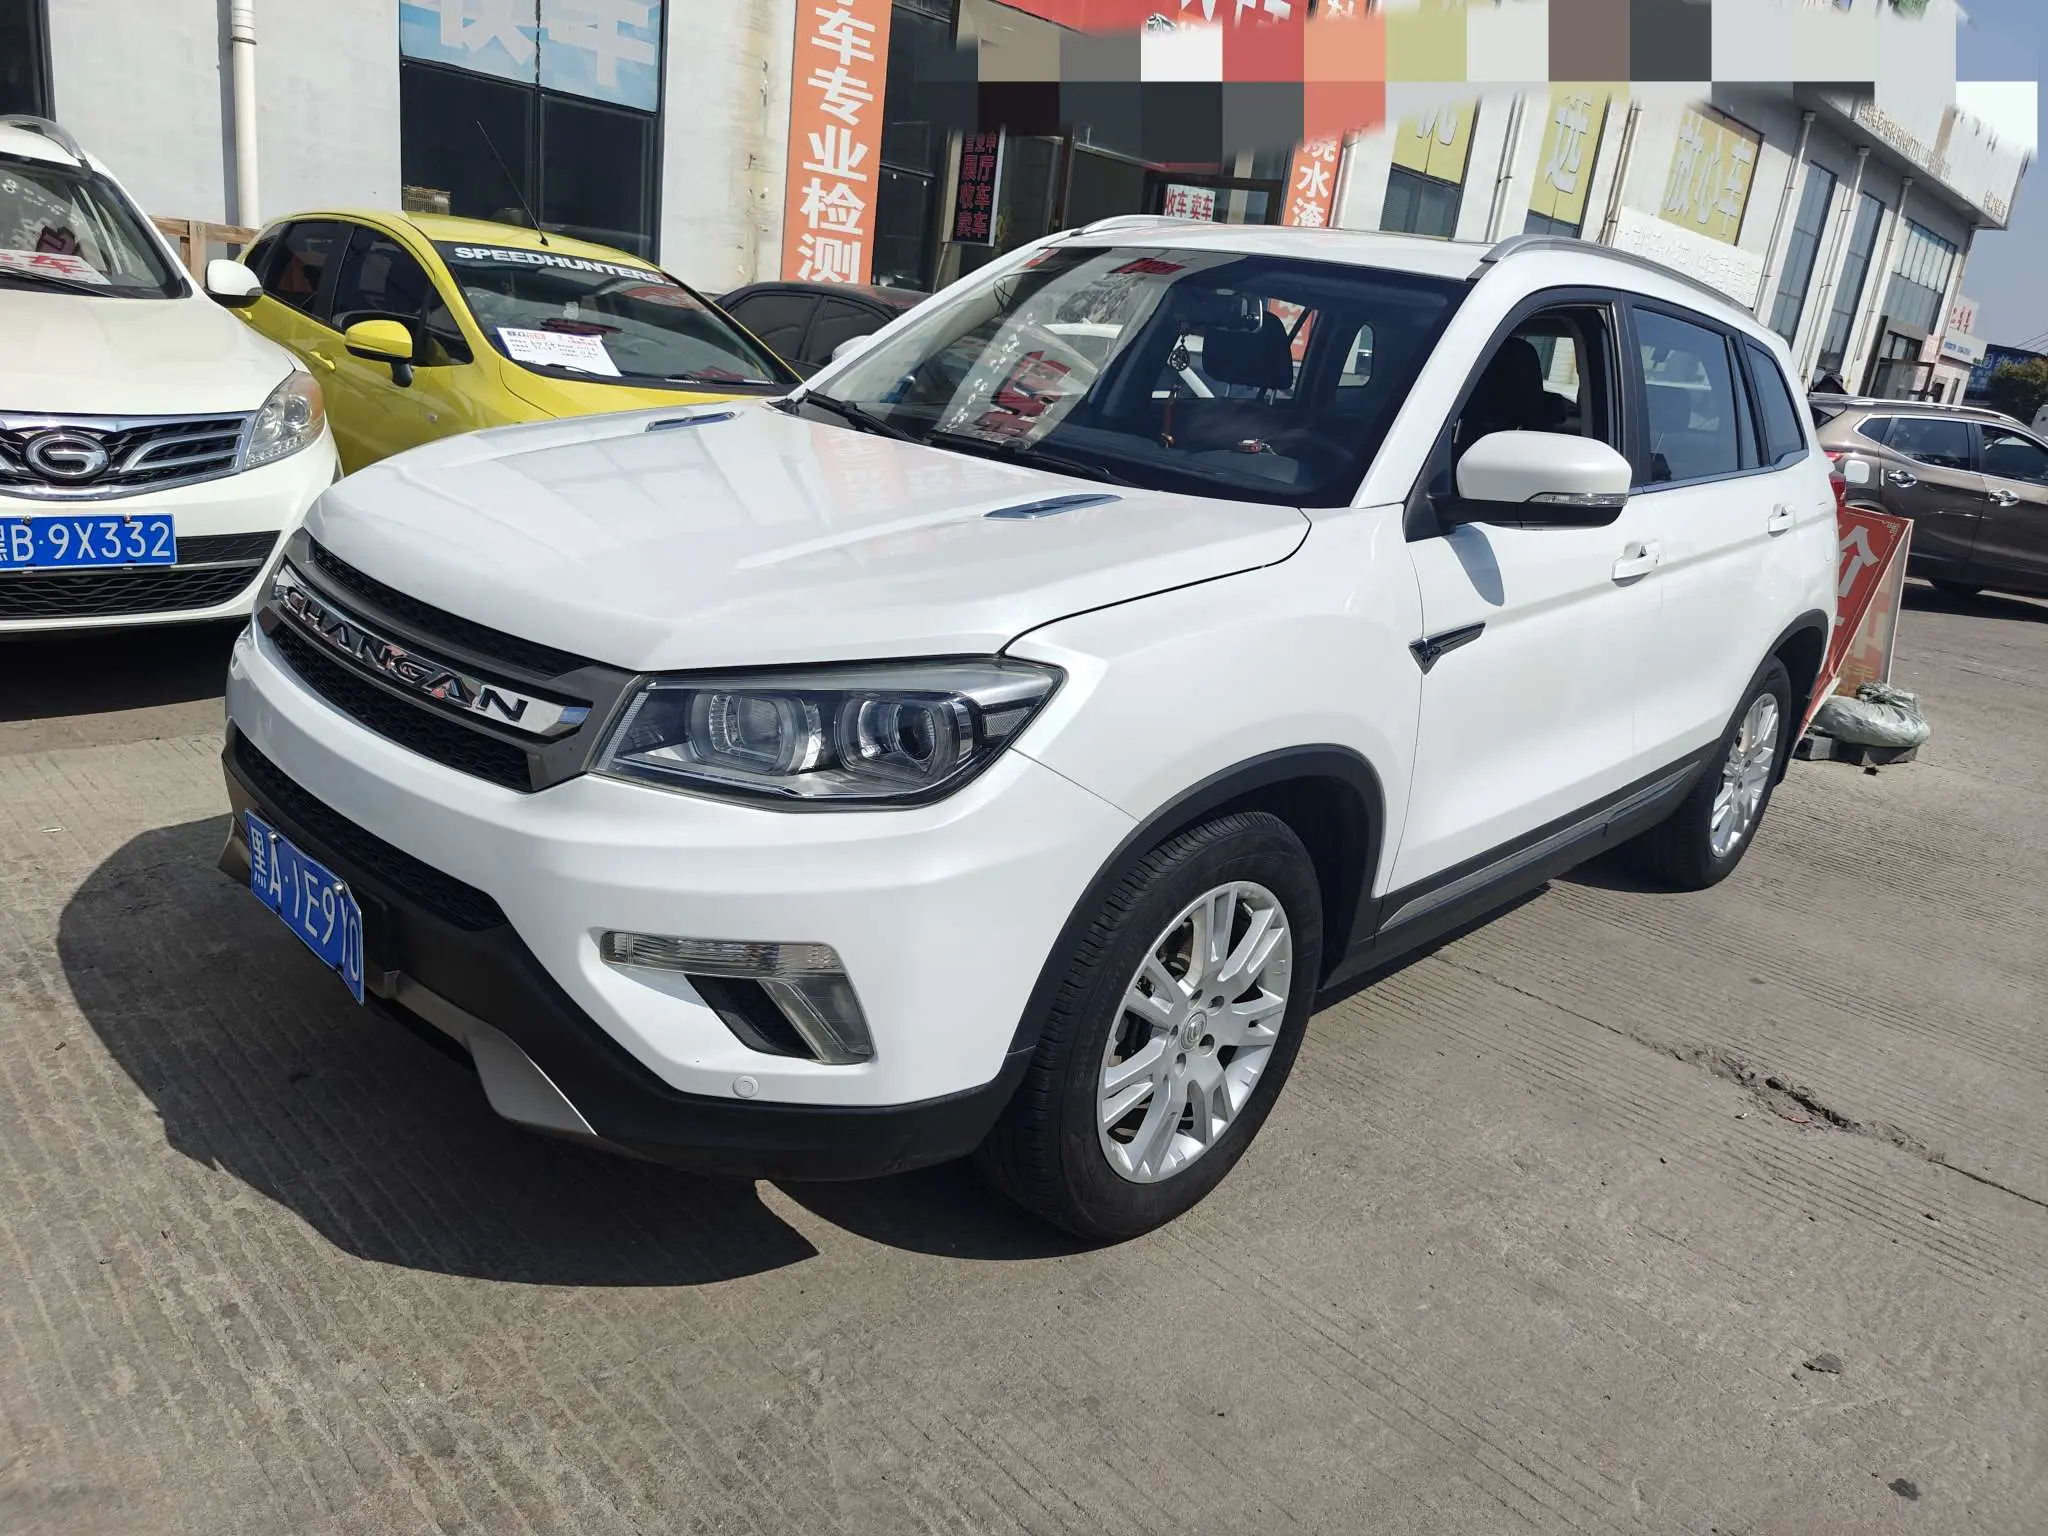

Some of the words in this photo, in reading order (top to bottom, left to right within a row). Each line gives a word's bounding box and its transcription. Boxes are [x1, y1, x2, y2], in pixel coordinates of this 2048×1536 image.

[797, 0, 876, 284] 车专业检测
[279, 586, 528, 723] CHANGAN
